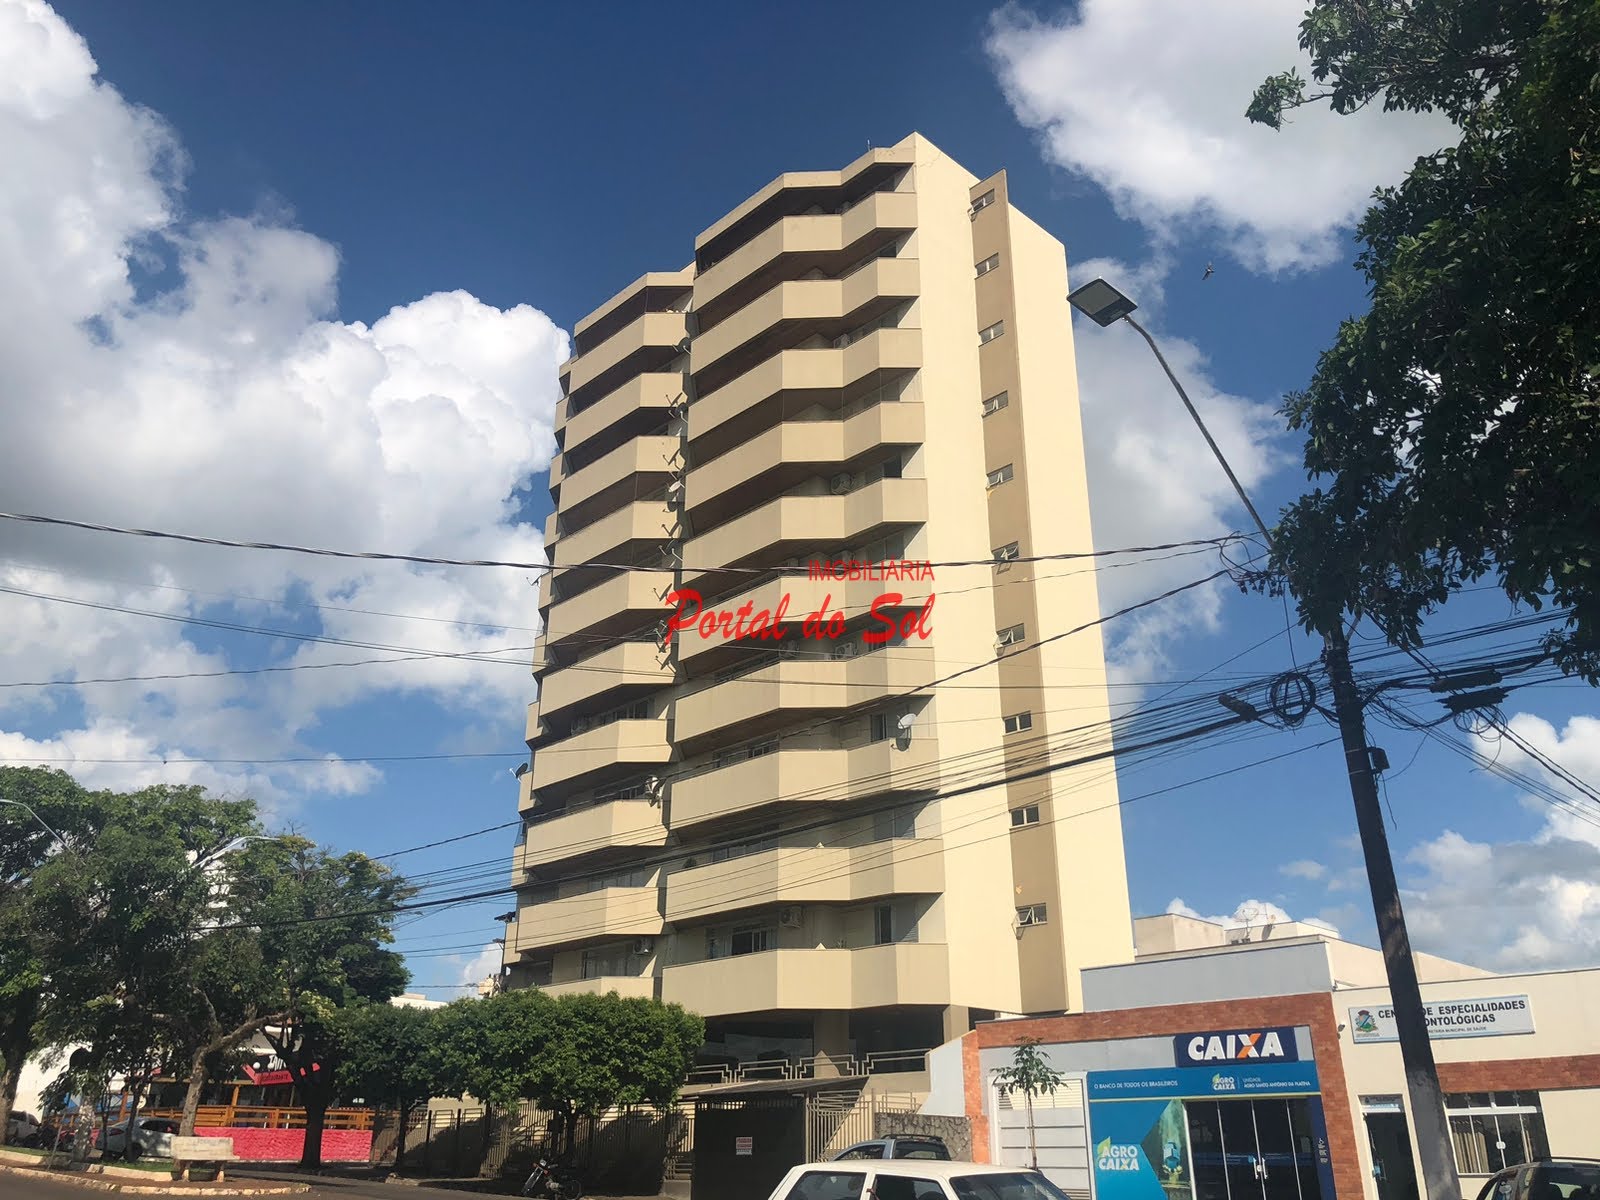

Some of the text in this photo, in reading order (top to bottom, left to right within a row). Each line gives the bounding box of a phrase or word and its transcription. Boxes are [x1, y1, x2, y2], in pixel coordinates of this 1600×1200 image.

[1438, 1000, 1526, 1015] ESPECIALIDADES
[1424, 1013, 1496, 1027] ONTOLÓGICAS
[1188, 1032, 1285, 1061] CAIXA
[1214, 1076, 1234, 1084] AGRO
[1099, 1145, 1138, 1158] AGRO
[1098, 1158, 1140, 1171] CAIXA
